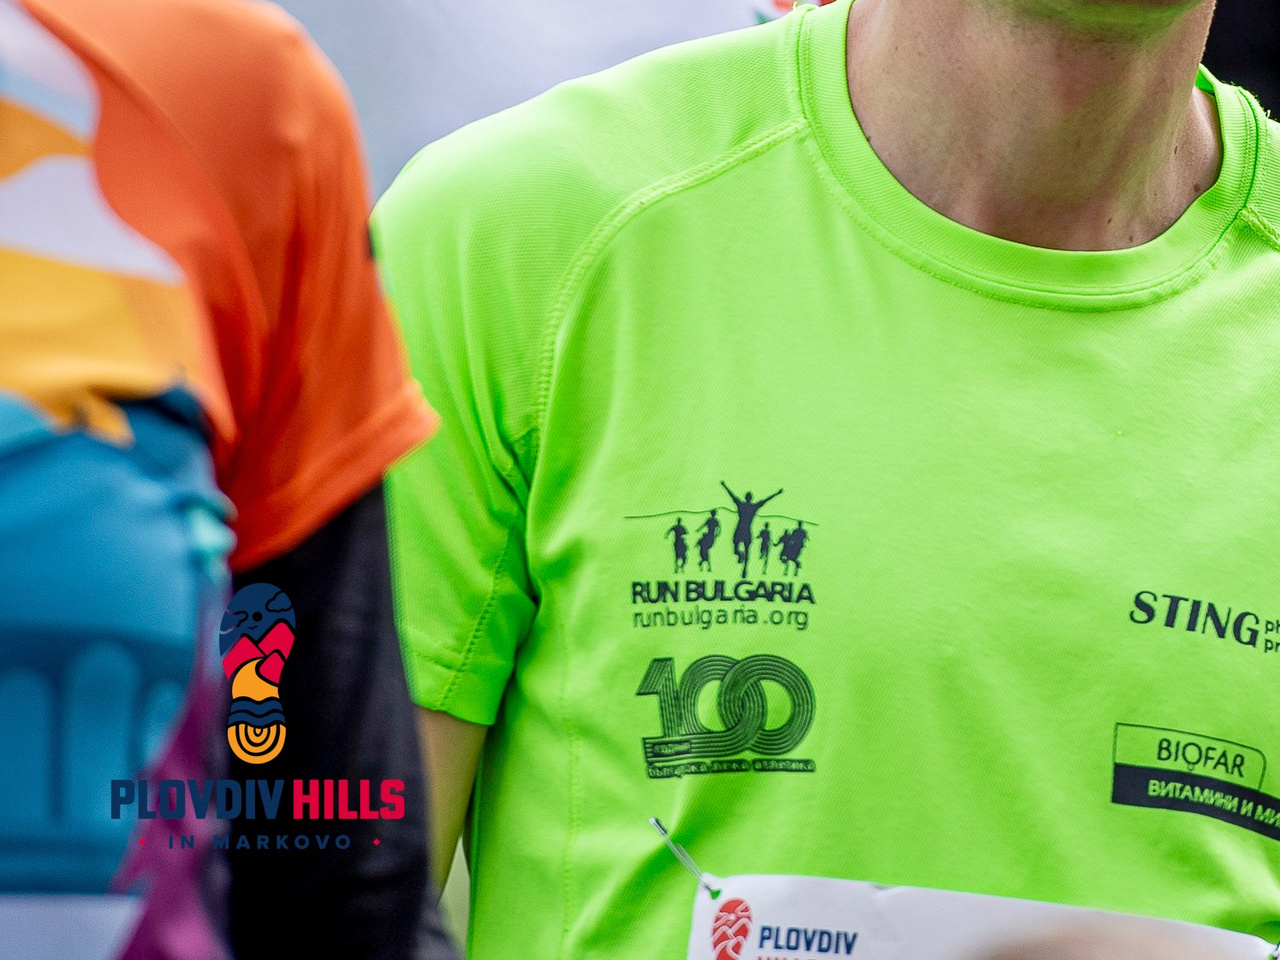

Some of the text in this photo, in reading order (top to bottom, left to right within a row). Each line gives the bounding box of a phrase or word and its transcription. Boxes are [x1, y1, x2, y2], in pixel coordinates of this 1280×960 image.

[632, 580, 816, 604] RUN BULGARIA
[634, 604, 809, 630] runbulgaria.org
[1129, 590, 1260, 648] STING
[636, 654, 816, 764] 100
[1157, 738, 1245, 778] BIOFAR
[1147, 779, 1238, 814] ВИТАМИНИ
[1241, 798, 1254, 817] И
[759, 925, 858, 955] PLOVDIV
